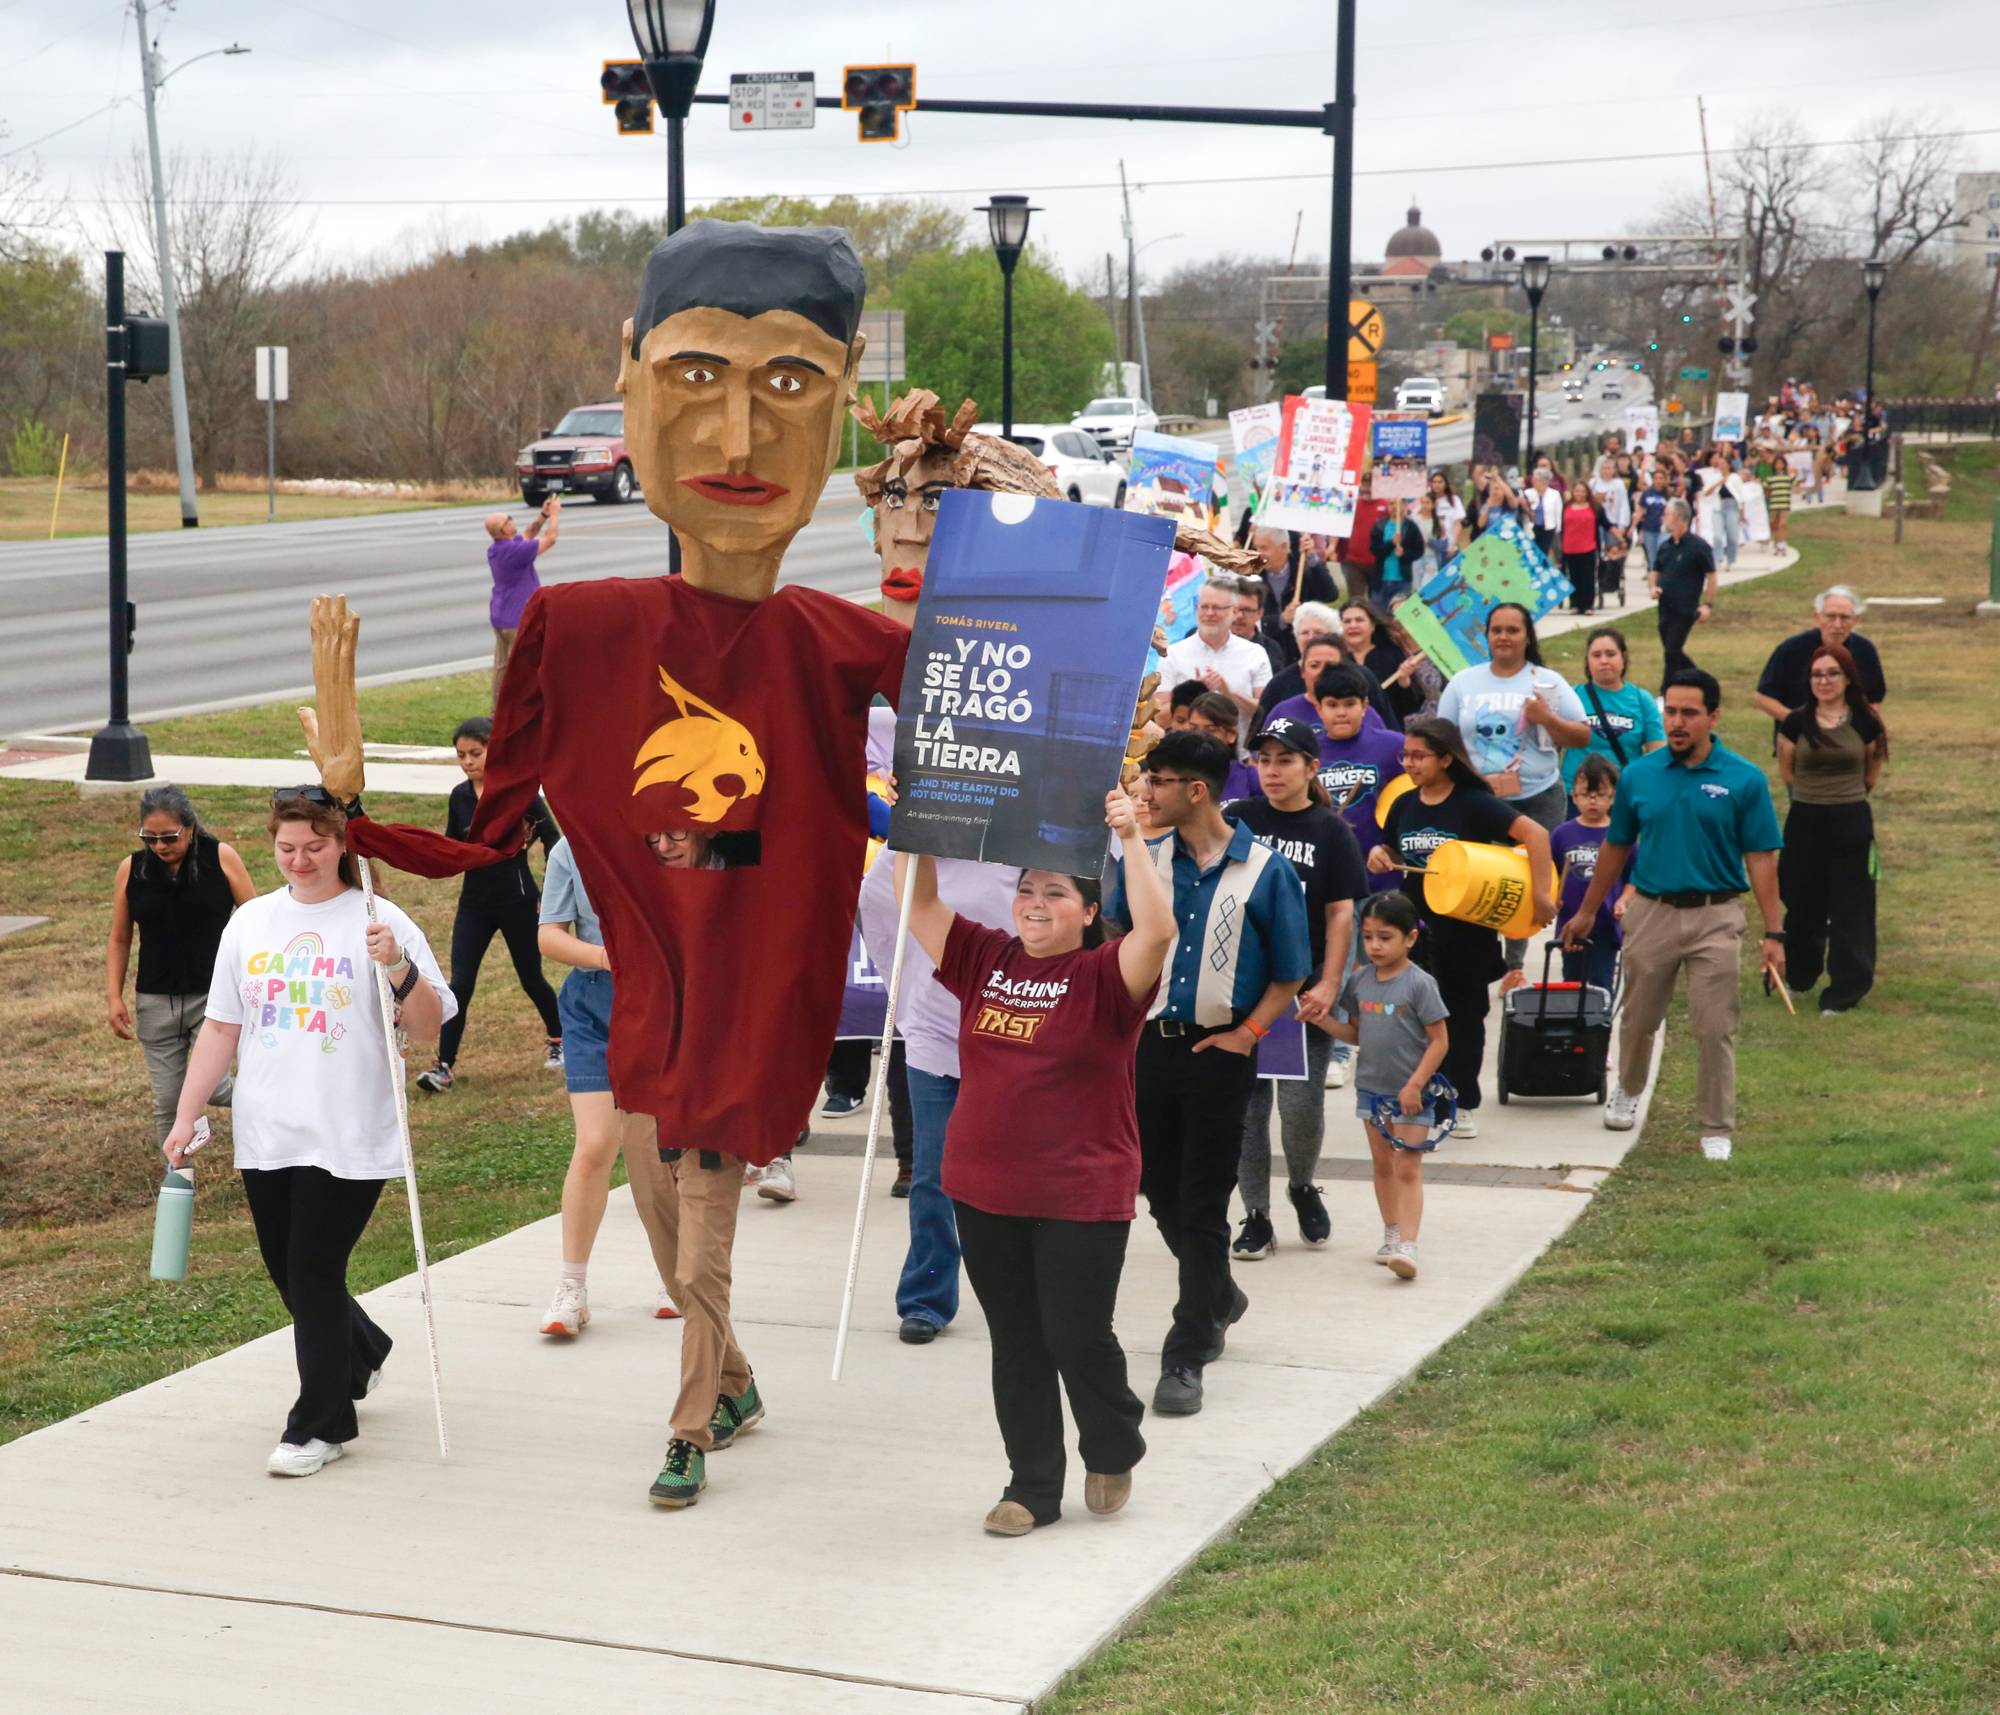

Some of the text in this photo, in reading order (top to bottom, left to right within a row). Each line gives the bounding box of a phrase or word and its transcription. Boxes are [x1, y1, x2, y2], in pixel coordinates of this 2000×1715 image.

[730, 100, 765, 109] ON RED
[734, 86, 762, 98] STOP
[1368, 323, 1379, 337] R
[935, 615, 1018, 632] TOMÁS RIVERA
[981, 641, 1031, 669] NO
[924, 662, 1012, 694] SE LO
[921, 689, 1033, 723] TRAGÓ
[915, 714, 955, 741] LA
[914, 740, 1021, 776] TIERRA
[910, 789, 995, 806] NOT DEVOUR HIM
[940, 780, 961, 791] THE
[962, 783, 997, 794] EARTH
[999, 786, 1019, 797] DID
[1277, 838, 1316, 867] YORK
[247, 951, 354, 979] GAMMA
[267, 979, 325, 1005] PHI
[987, 970, 1069, 999] TEACHING
[261, 1003, 327, 1035] BETA
[978, 1007, 1041, 1038] TXST
